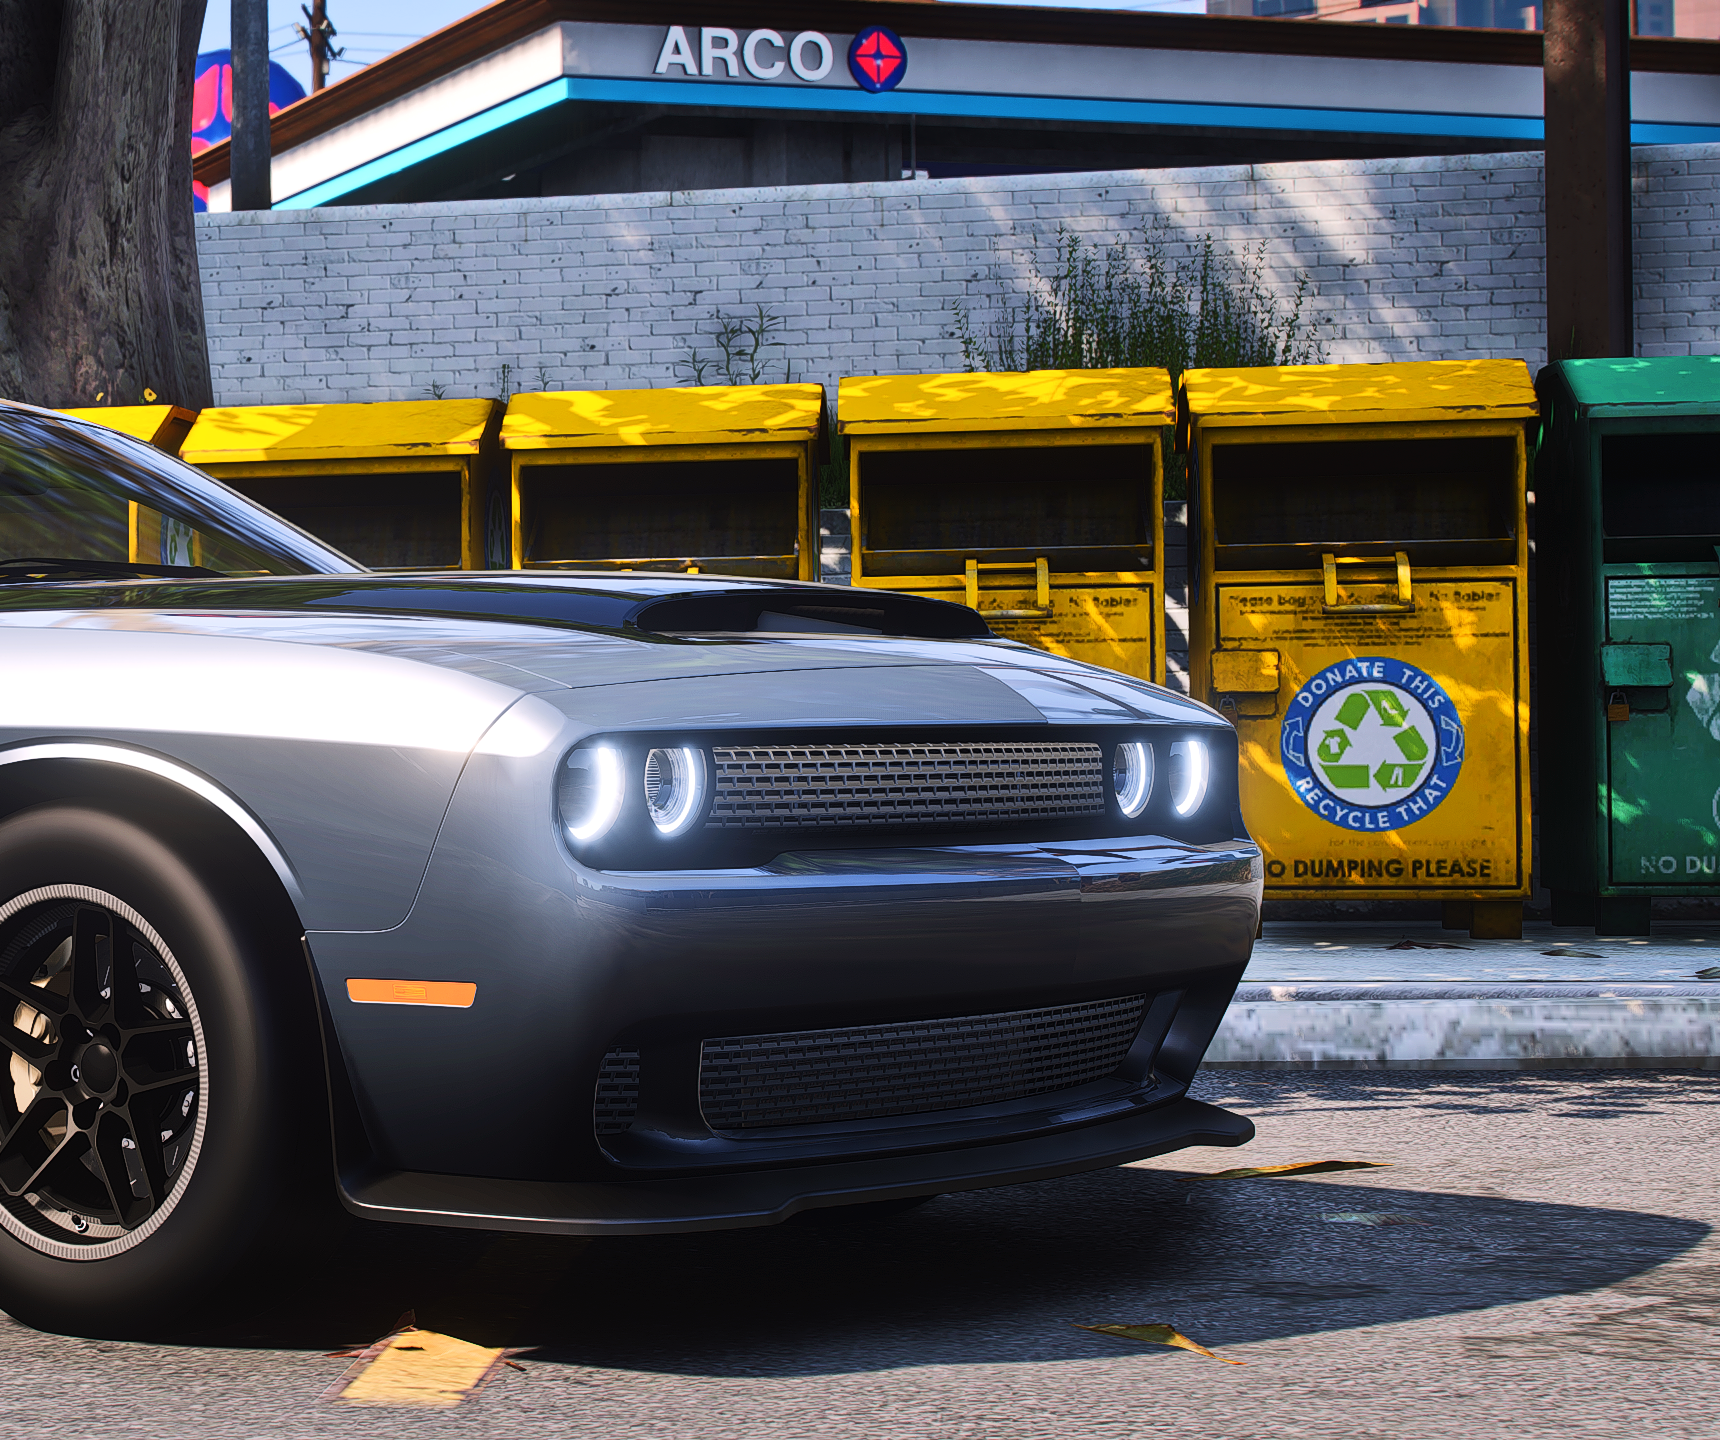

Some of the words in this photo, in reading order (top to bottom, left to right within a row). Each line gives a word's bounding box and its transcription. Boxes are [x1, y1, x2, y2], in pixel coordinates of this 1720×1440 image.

[654, 25, 834, 81] ARCO
[1296, 661, 1385, 708] DONATE
[1401, 668, 1446, 709] THIS
[1295, 776, 1391, 829] RECYCLE
[1396, 773, 1447, 822] THAT
[1264, 859, 1286, 878] O
[1293, 859, 1405, 878] DUMPING
[1411, 858, 1492, 878] PLEASE
[1640, 856, 1677, 874] NO
[1685, 855, 1720, 874] DU
